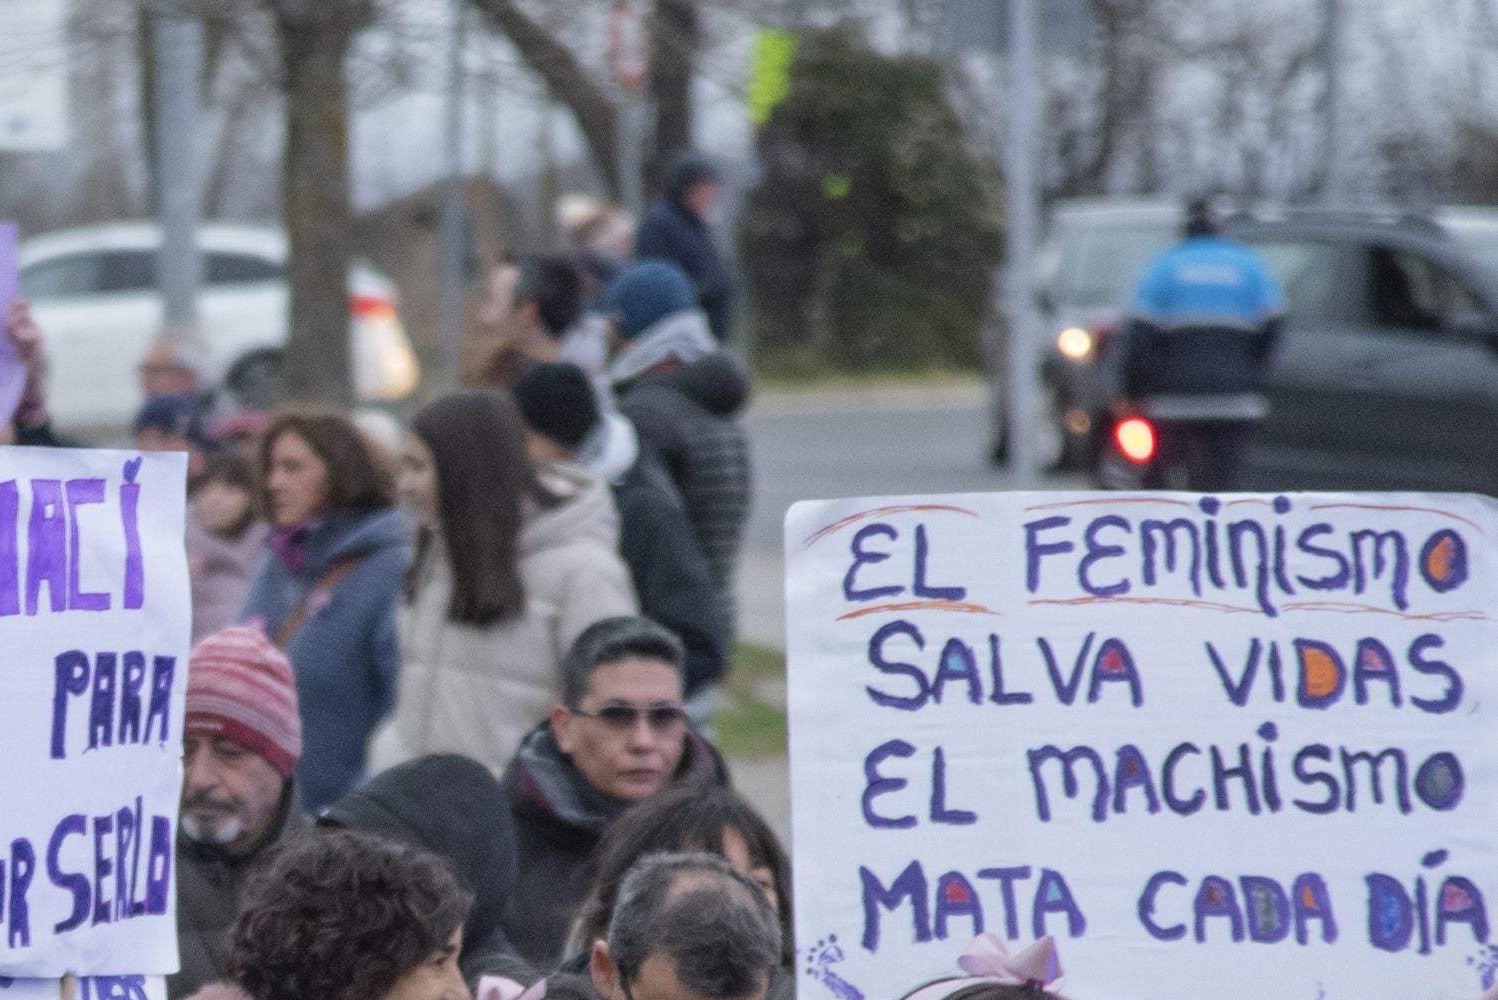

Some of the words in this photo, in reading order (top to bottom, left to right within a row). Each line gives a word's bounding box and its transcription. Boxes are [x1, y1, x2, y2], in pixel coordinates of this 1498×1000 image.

[842, 522, 969, 602] EL
[1022, 495, 1470, 618] FEMINISMO
[49, 649, 178, 760] PARA
[865, 619, 1145, 712] SALVA
[1205, 632, 1466, 714] VIDAS
[860, 739, 978, 829] EL
[1027, 720, 1466, 824] MACHISMO
[45, 794, 172, 935] SERLO
[858, 860, 1087, 952] MATA
[1137, 869, 1339, 946] CADA
[1364, 849, 1491, 956] DÍA
